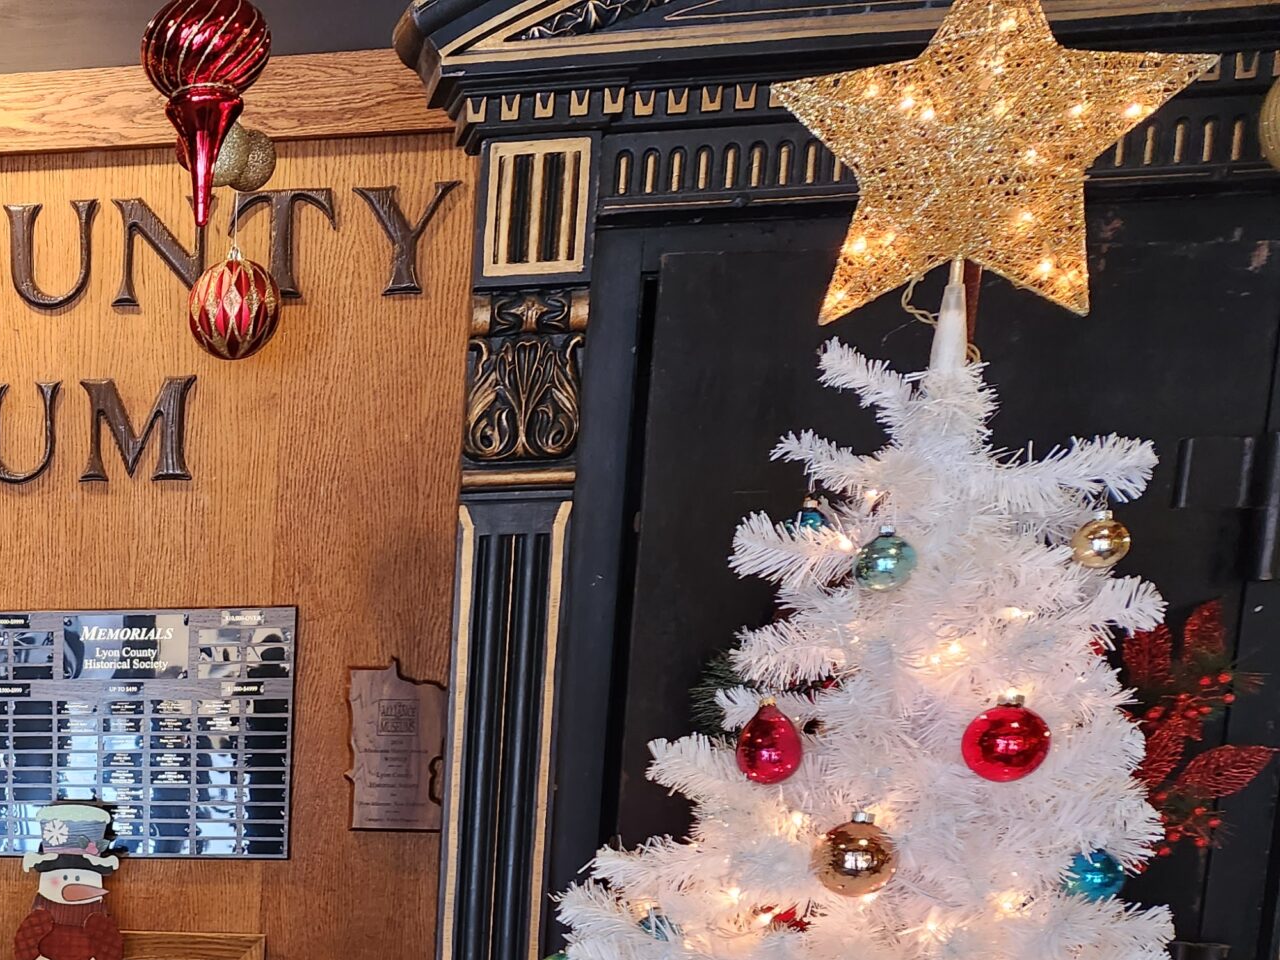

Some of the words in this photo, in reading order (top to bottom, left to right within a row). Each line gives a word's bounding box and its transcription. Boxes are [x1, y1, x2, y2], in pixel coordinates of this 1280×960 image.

[80, 626, 174, 640] MEMORIALS
[96, 648, 120, 659] Lyon
[122, 647, 158, 659] County
[84, 659, 130, 669] Historical
[132, 659, 168, 671] Society
